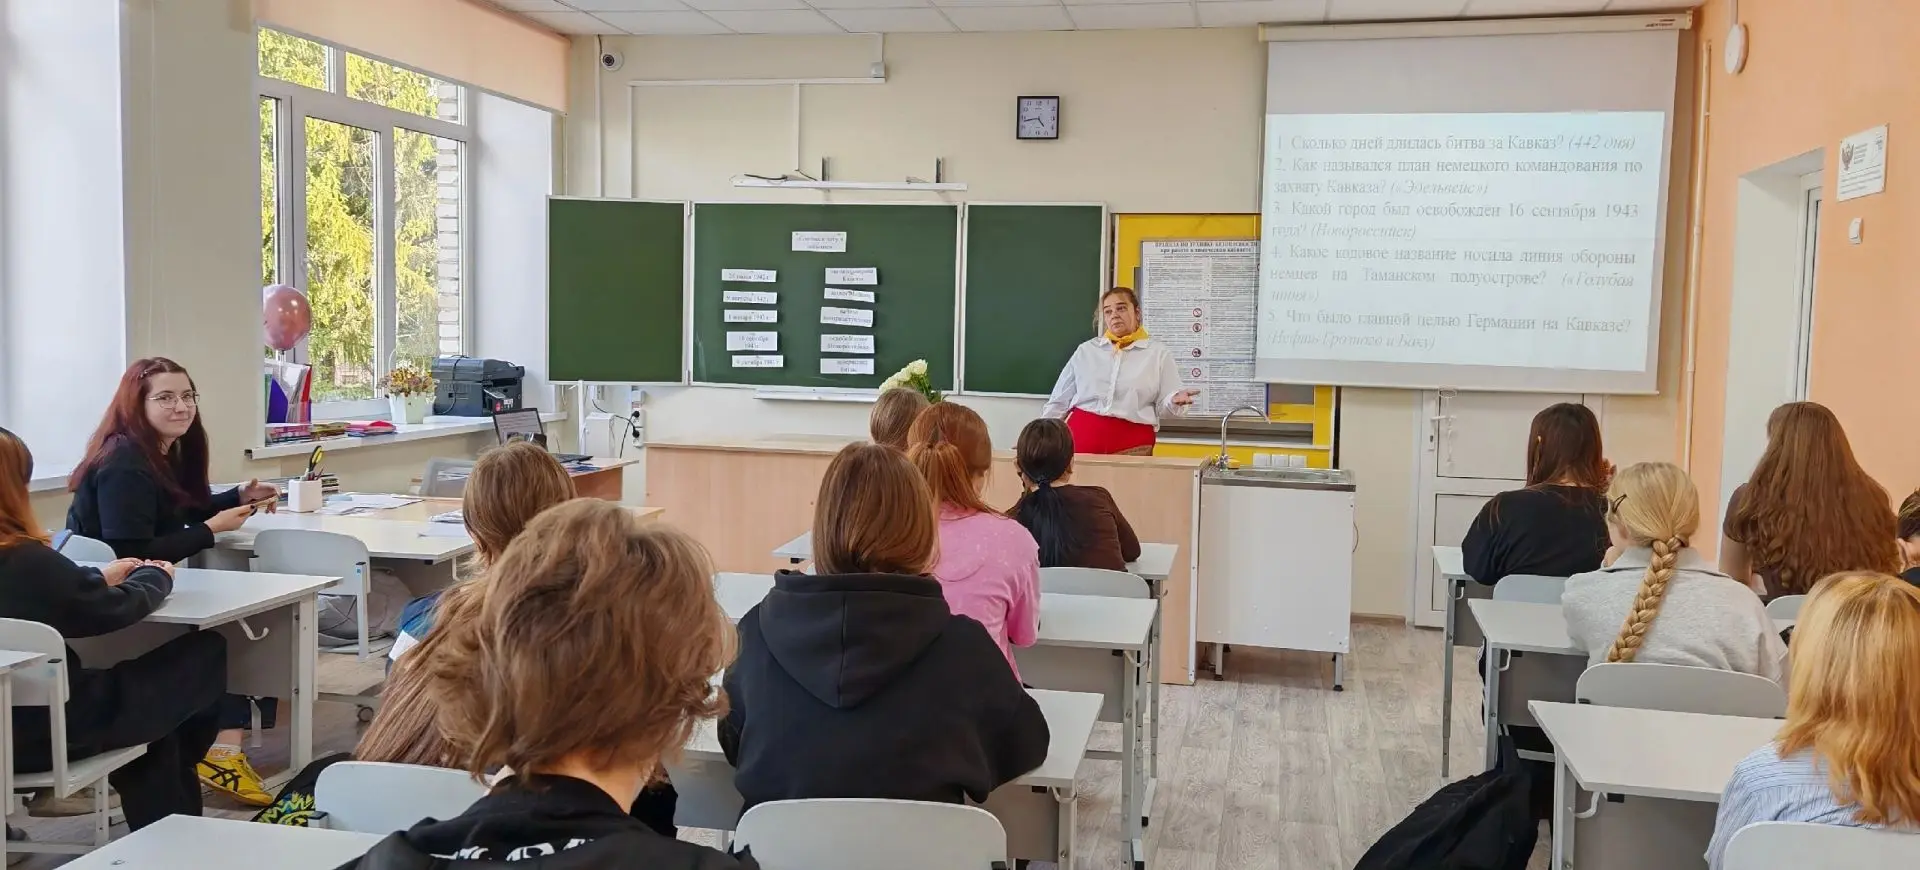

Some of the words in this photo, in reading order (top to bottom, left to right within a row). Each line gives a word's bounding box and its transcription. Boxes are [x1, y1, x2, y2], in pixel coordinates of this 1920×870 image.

[1291, 135, 1347, 151] Сколько
[1351, 135, 1383, 151] дней
[1387, 137, 1442, 151] длилась
[1445, 134, 1486, 150] битва
[1489, 137, 1503, 149] за
[1507, 134, 1564, 151] Кавказ?
[1568, 134, 1602, 150] (442
[1292, 158, 1320, 172] Как
[1322, 160, 1392, 172] назывался
[1397, 160, 1430, 172] план
[1436, 161, 1510, 174] немецкого
[1515, 161, 1618, 175] командования
[1624, 161, 1643, 173] по
[1273, 182, 1321, 197] захвату
[1327, 179, 1387, 194] Кавказа?
[1292, 201, 1332, 216] Какой
[1338, 204, 1377, 219] город
[1383, 202, 1410, 216] был
[1416, 202, 1502, 217] освобожден
[1509, 203, 1525, 217] 16
[1531, 203, 1597, 220] сентября
[1605, 204, 1640, 218] 1943
[1290, 245, 1329, 259] Какое
[1335, 249, 1389, 261] кодовое
[1394, 250, 1457, 261] название
[1463, 250, 1513, 262] носила
[1519, 251, 1563, 263] линия
[1571, 248, 1636, 268] обороны
[1270, 269, 1319, 281] немцев
[1332, 270, 1348, 281] на
[1362, 268, 1436, 283] Таманском
[1450, 271, 1547, 287] полуострове?
[1287, 309, 1311, 323] Что
[1317, 309, 1352, 324] было
[1358, 312, 1411, 326] главной
[1416, 314, 1461, 328] целью
[1466, 314, 1536, 331] Германии
[1543, 318, 1558, 330] на
[1566, 316, 1631, 333] Кавказе?
